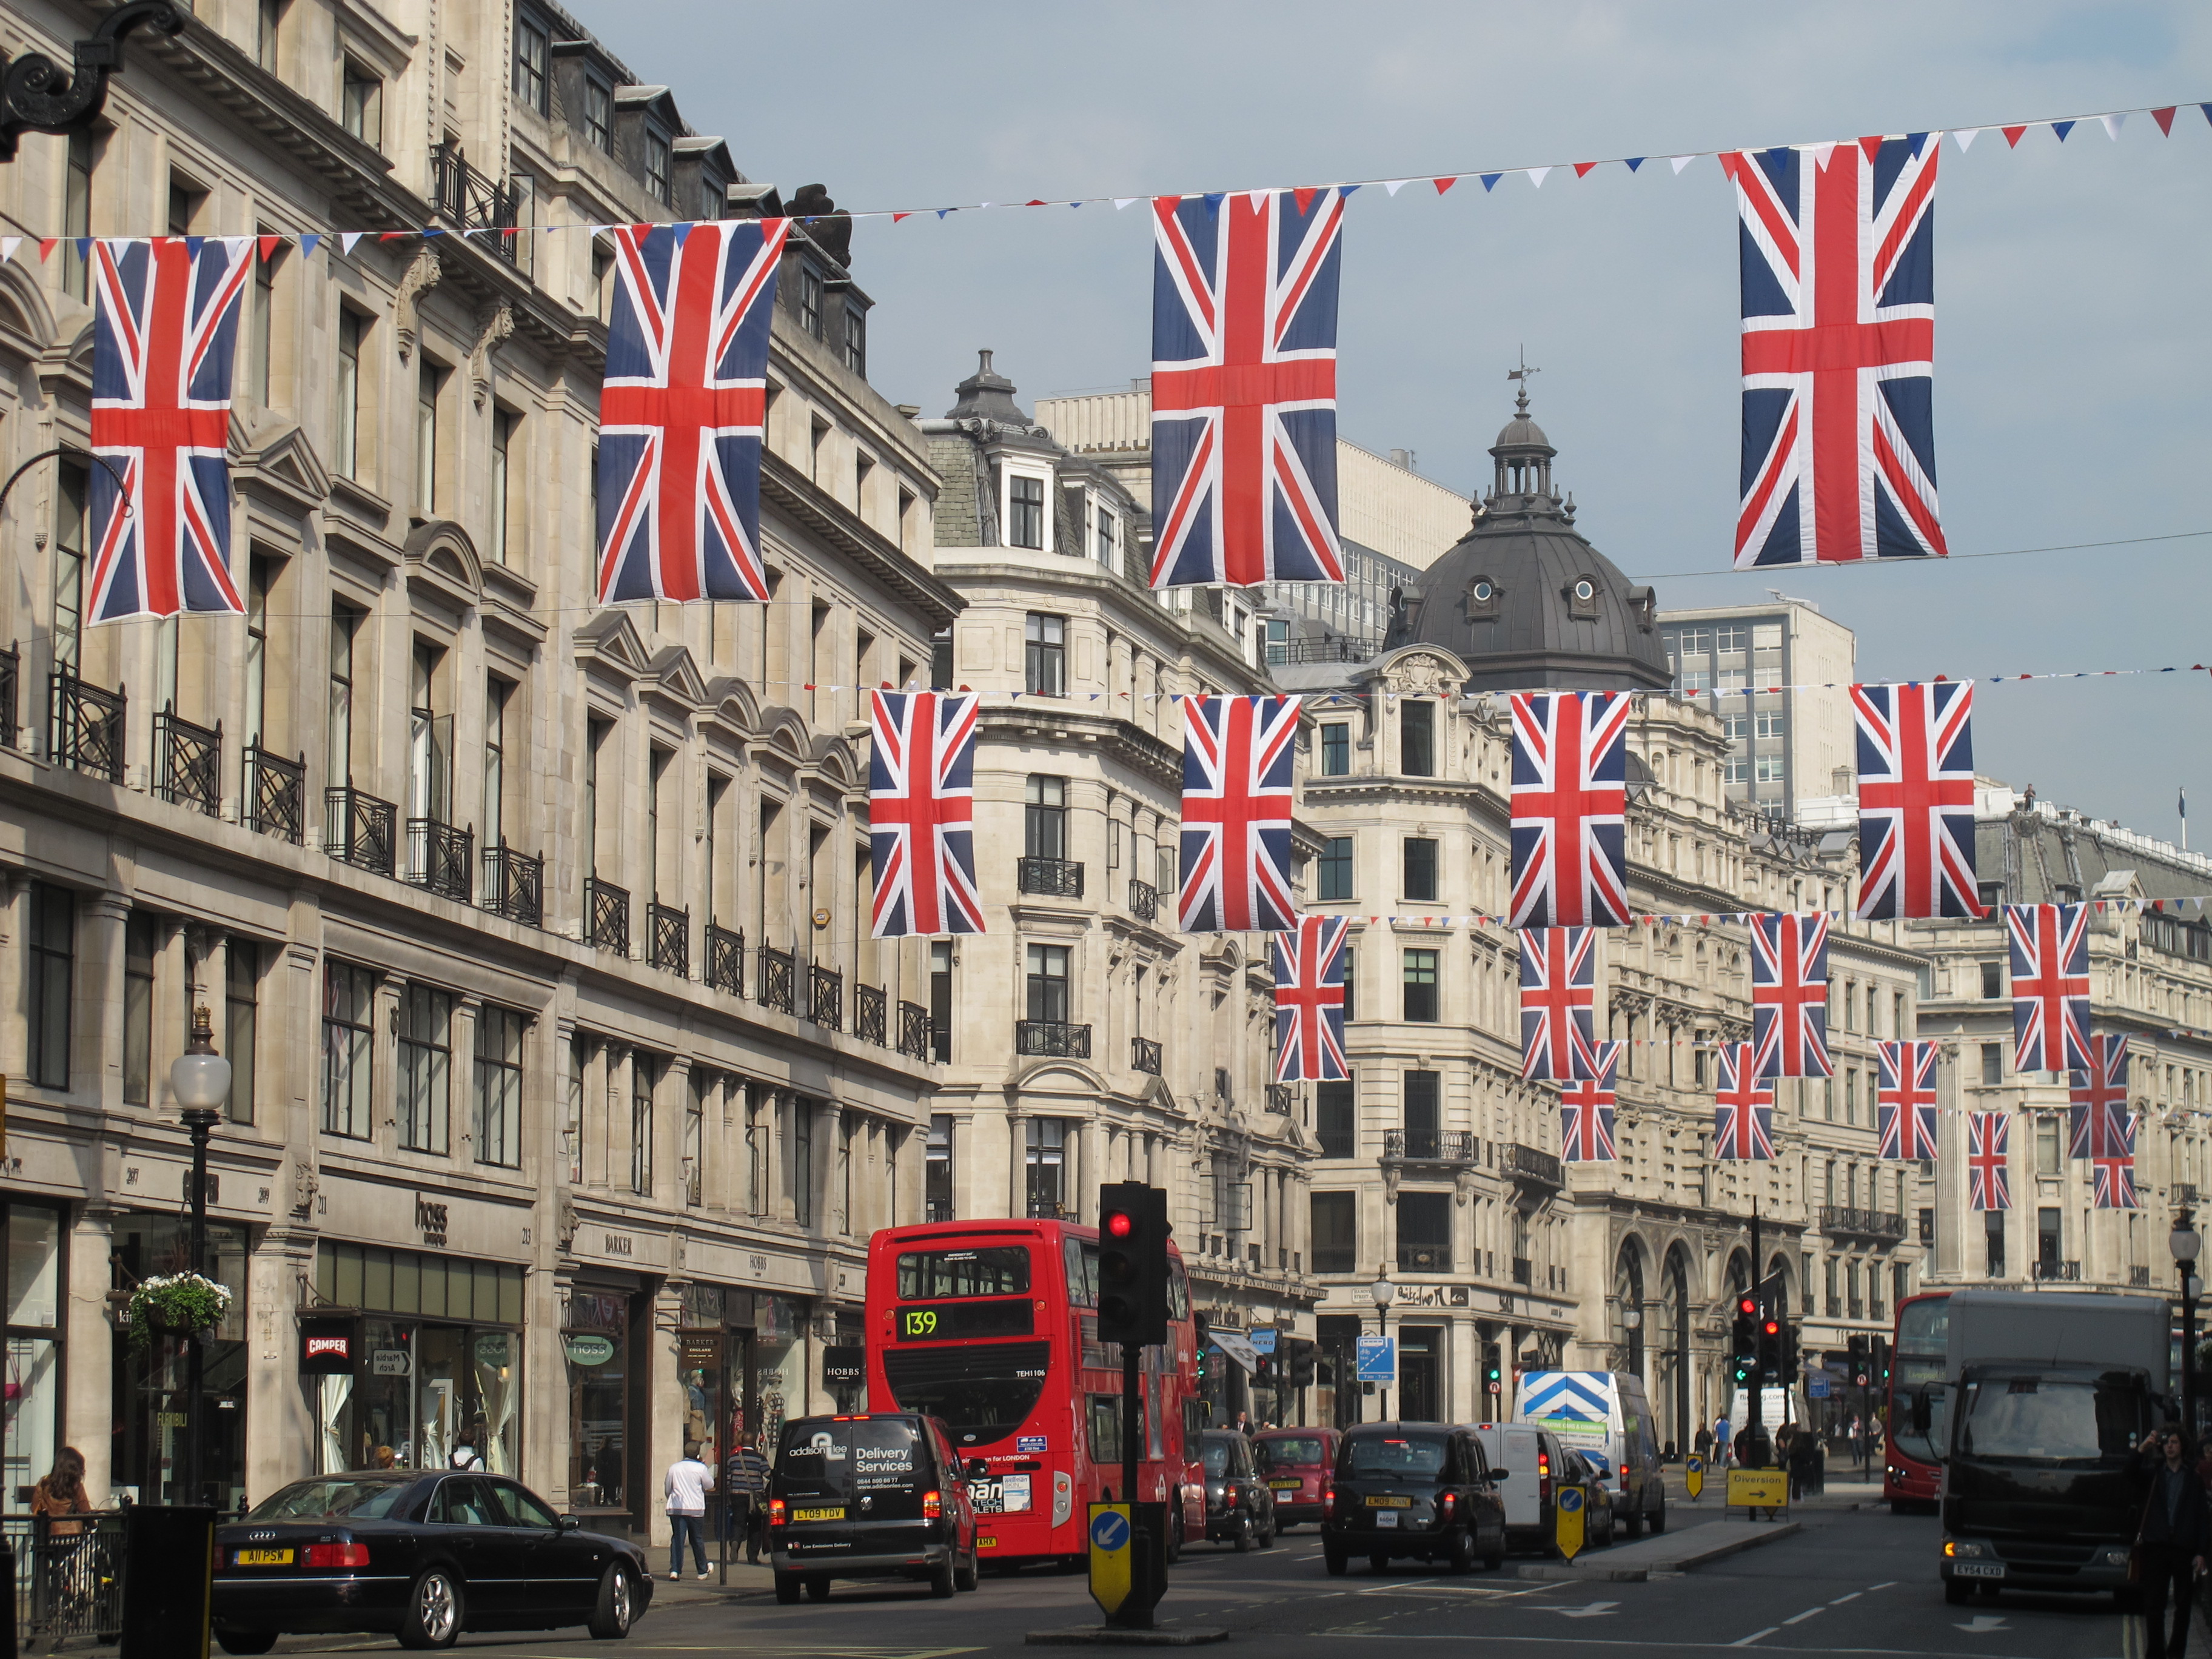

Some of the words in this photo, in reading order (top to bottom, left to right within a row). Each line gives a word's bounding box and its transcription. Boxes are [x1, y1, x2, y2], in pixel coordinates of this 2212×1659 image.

[415, 1191, 447, 1233] hoss
[521, 1227, 531, 1244] 213
[605, 1233, 632, 1256] BARKER
[749, 1254, 767, 1270] HOBBS
[907, 1311, 937, 1335] 139
[309, 1339, 347, 1354] CAMPER
[574, 1342, 605, 1354] hoss
[789, 1446, 825, 1456] addison
[833, 1445, 848, 1453] lee
[856, 1447, 909, 1460] Delivery
[856, 1460, 913, 1473] Services
[1735, 1475, 1781, 1483] Diversion
[797, 1509, 821, 1518] LT09
[823, 1509, 841, 1517] TDV
[263, 1550, 284, 1561] PSW
[1957, 1564, 1980, 1575] EY54
